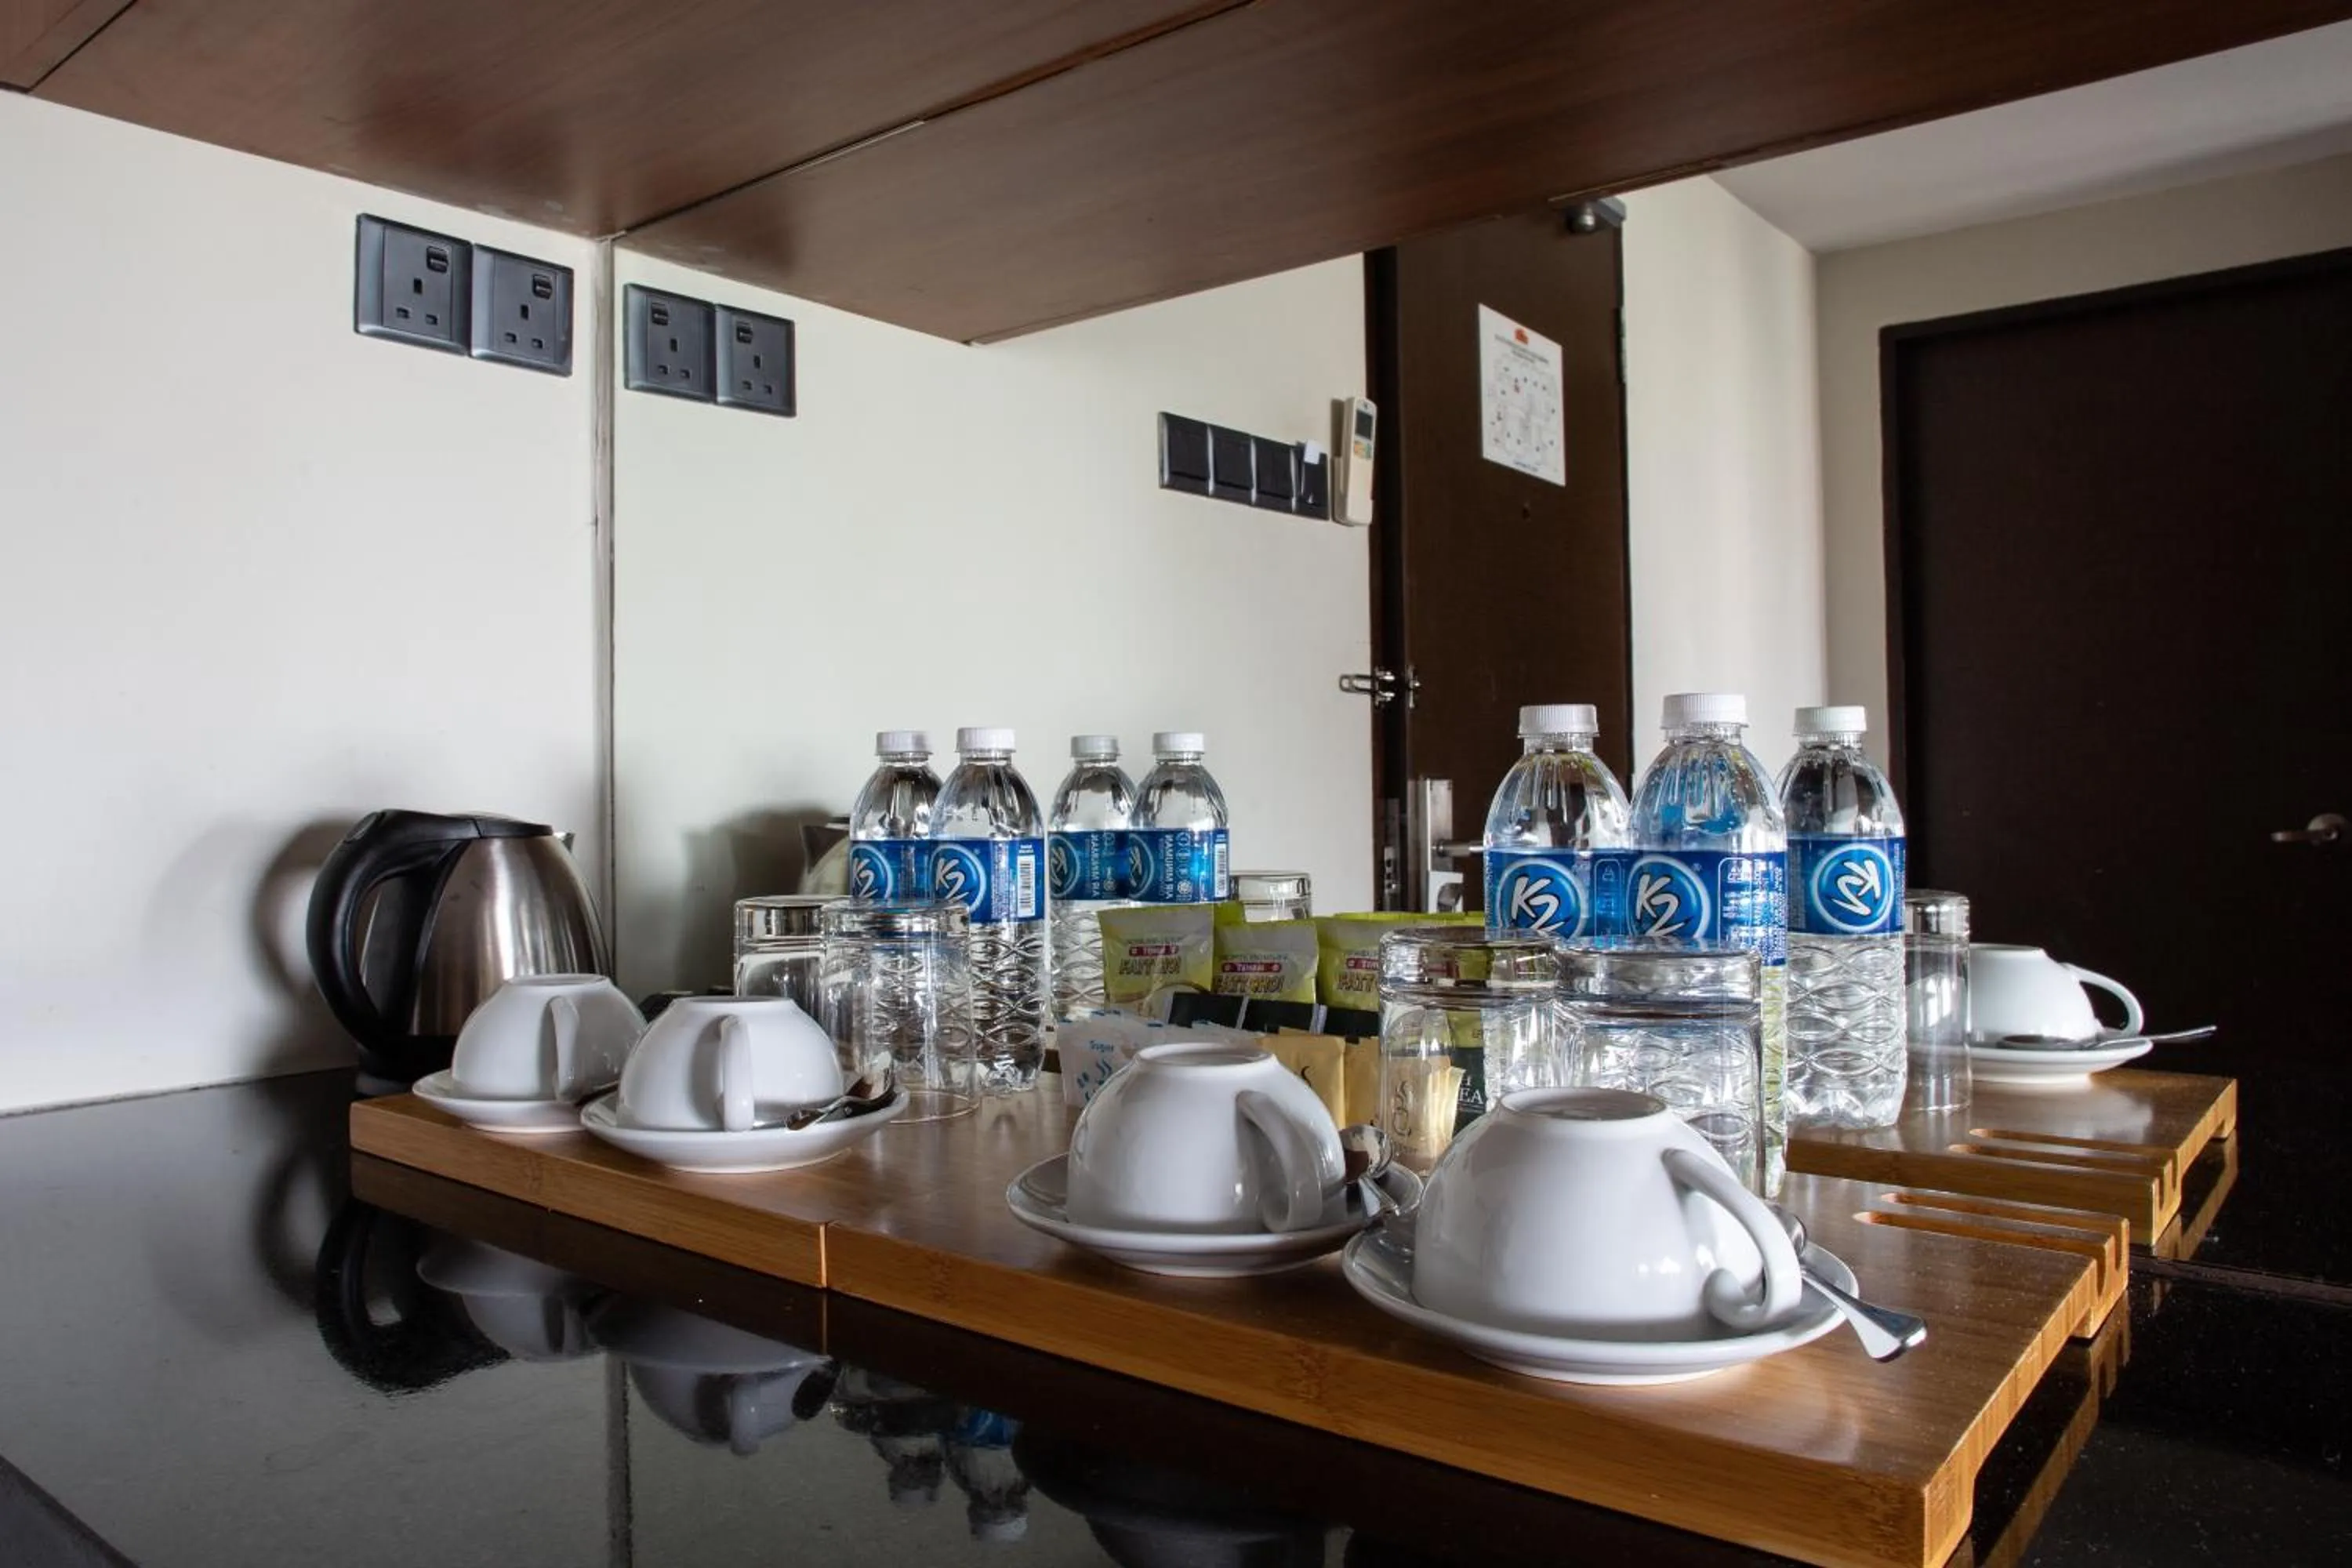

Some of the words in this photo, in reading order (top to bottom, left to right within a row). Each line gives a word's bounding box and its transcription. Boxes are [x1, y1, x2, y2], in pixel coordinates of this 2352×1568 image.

[935, 858, 969, 902] K2
[1512, 876, 1566, 933] K2
[1635, 874, 1686, 936] K2
[1459, 1088, 1484, 1104] EA
